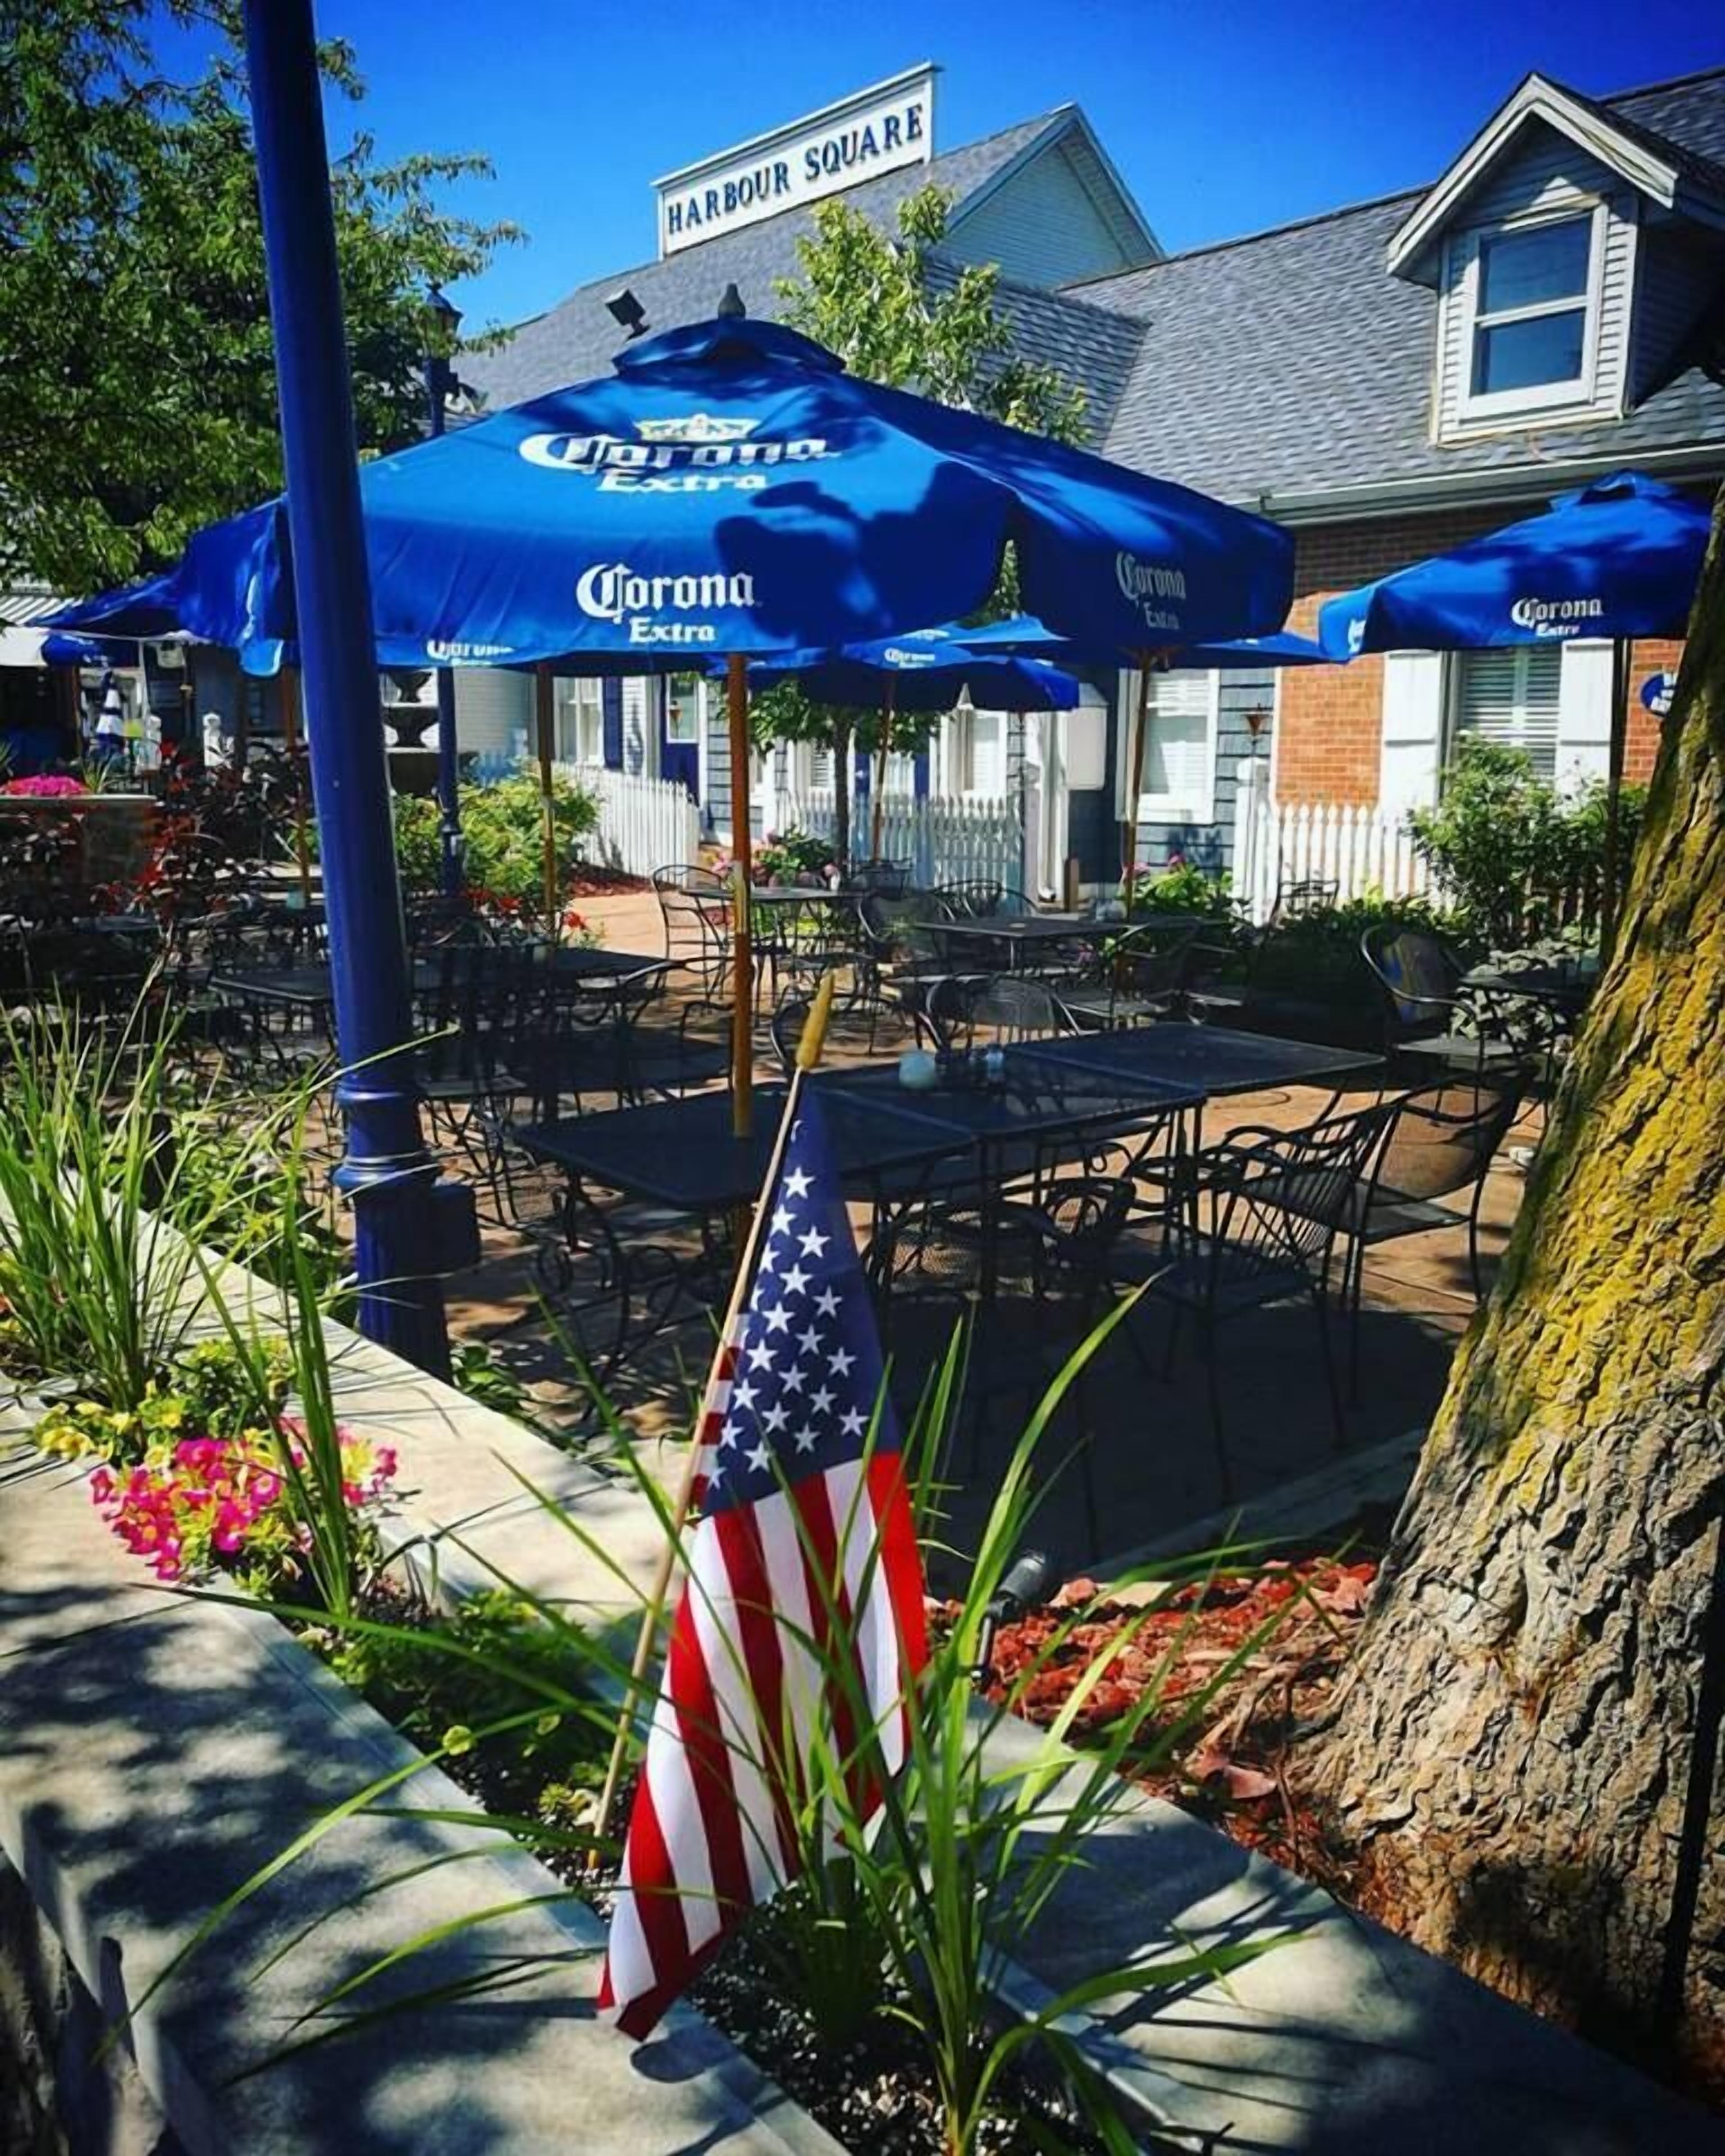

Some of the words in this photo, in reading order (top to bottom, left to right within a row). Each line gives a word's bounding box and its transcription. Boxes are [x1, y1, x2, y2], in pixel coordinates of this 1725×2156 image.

[668, 162, 791, 234] HARBOUR
[804, 103, 924, 181] SQUARE
[519, 433, 841, 474] Corona
[596, 468, 767, 492] Extra
[576, 563, 756, 624] Corona
[1116, 551, 1186, 607] Corona
[629, 616, 716, 643] Extra
[1511, 597, 1604, 629] Corona
